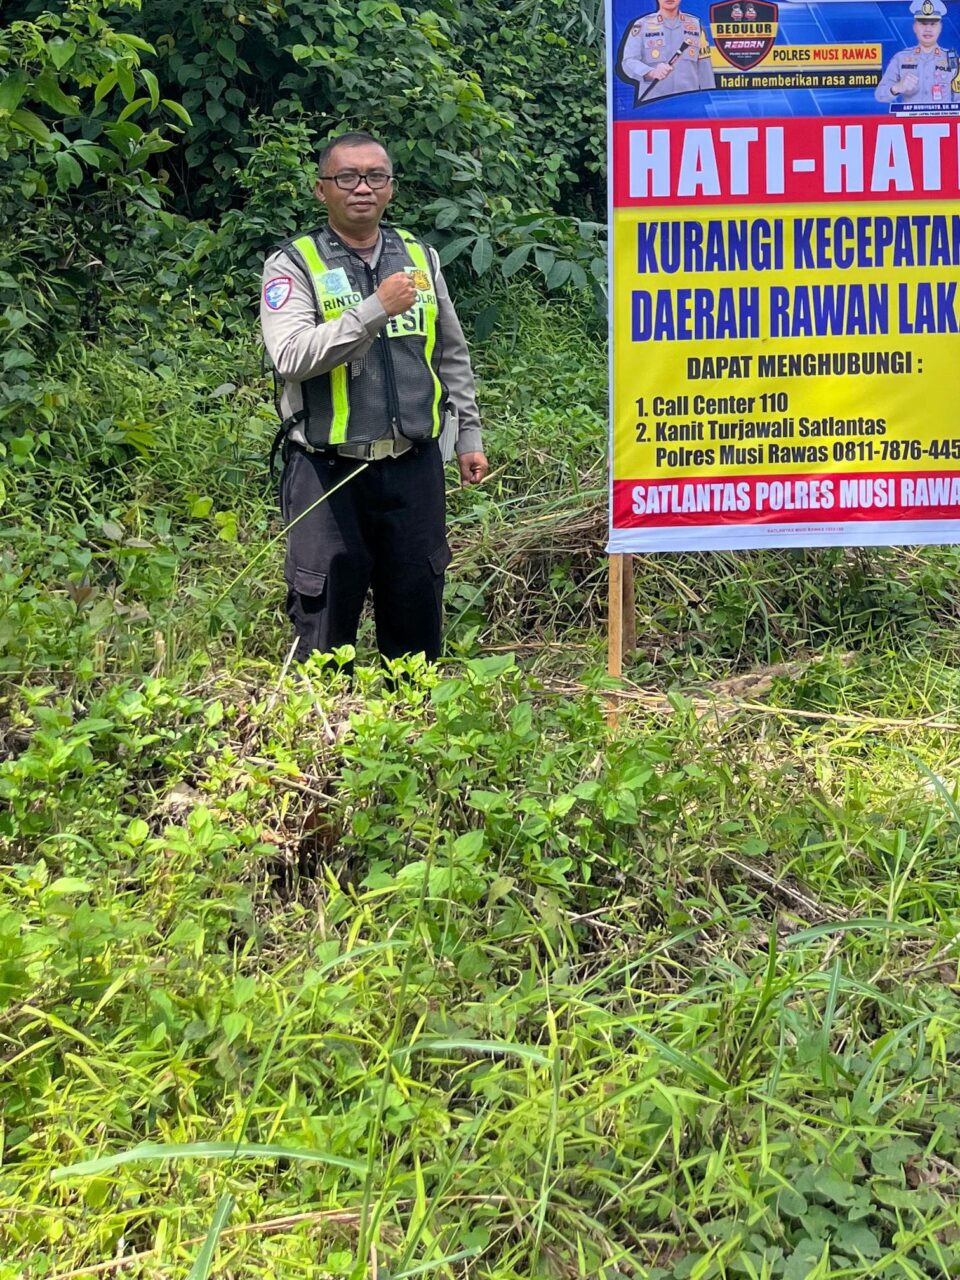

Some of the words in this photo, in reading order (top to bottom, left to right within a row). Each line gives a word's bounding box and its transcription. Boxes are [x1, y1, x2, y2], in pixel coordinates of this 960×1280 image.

[716, 24, 772, 34] BEDULUR
[724, 40, 765, 49] REBORN
[773, 49, 810, 62] POLRES
[813, 48, 839, 61] MUSI
[842, 47, 877, 60] RAWAS
[720, 73, 758, 88] hadir
[761, 73, 819, 87] memberikan
[822, 77, 847, 87] rasa
[849, 75, 878, 86] aman
[637, 219, 784, 274] KURANGI
[323, 294, 361, 312] RINTO
[415, 294, 436, 305] OLRI
[631, 287, 760, 342] DAERAH
[770, 282, 889, 338] RAWAN
[687, 356, 754, 379] DAPAT
[757, 351, 912, 378] MENGHUBUNGI
[635, 397, 649, 417] 1.
[652, 395, 689, 417] Call
[693, 394, 756, 415] Center
[759, 392, 788, 413] 110
[635, 423, 651, 443] 2.
[655, 420, 704, 442] Kanit
[709, 417, 795, 441] Turjawali
[799, 416, 886, 438] Satlantas
[656, 444, 715, 467] Polres
[719, 442, 764, 465] Musi
[768, 441, 829, 463] Rawas
[631, 481, 750, 515] SATLANTAS
[756, 479, 834, 509] POLRES
[839, 478, 896, 509] MUSI
